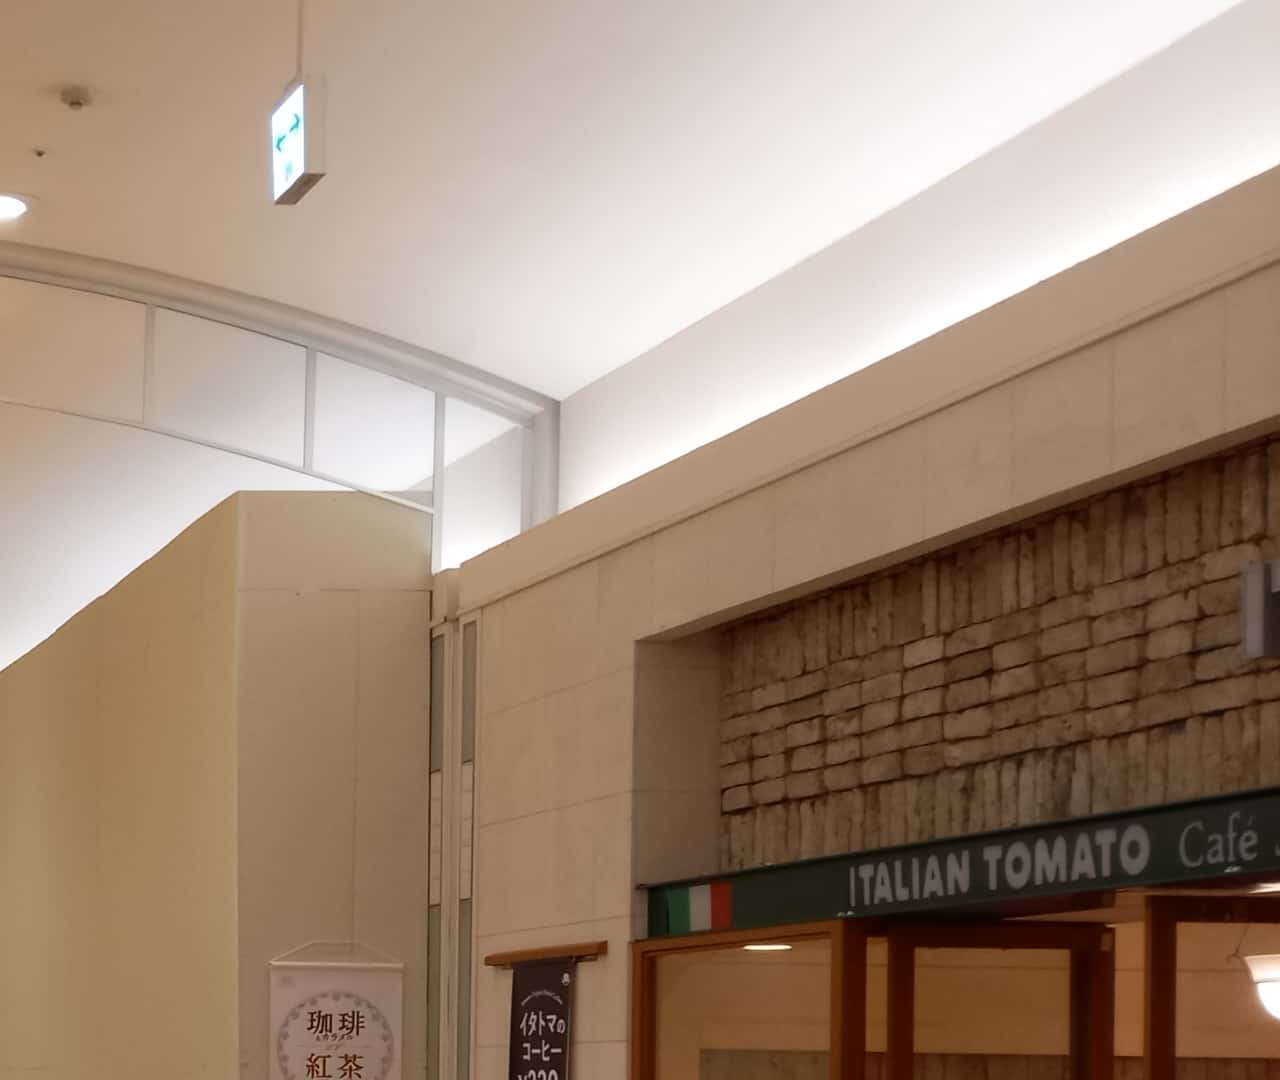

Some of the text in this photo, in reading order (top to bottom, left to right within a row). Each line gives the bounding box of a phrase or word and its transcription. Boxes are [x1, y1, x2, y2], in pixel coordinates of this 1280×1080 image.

[848, 811, 1258, 908] ITALIAN TOMATO Café
[306, 1010, 366, 1036] 珈琲
[520, 1010, 566, 1036] イタトマの
[522, 1040, 562, 1061] コーヒー
[306, 1053, 364, 1079] 紅茶
